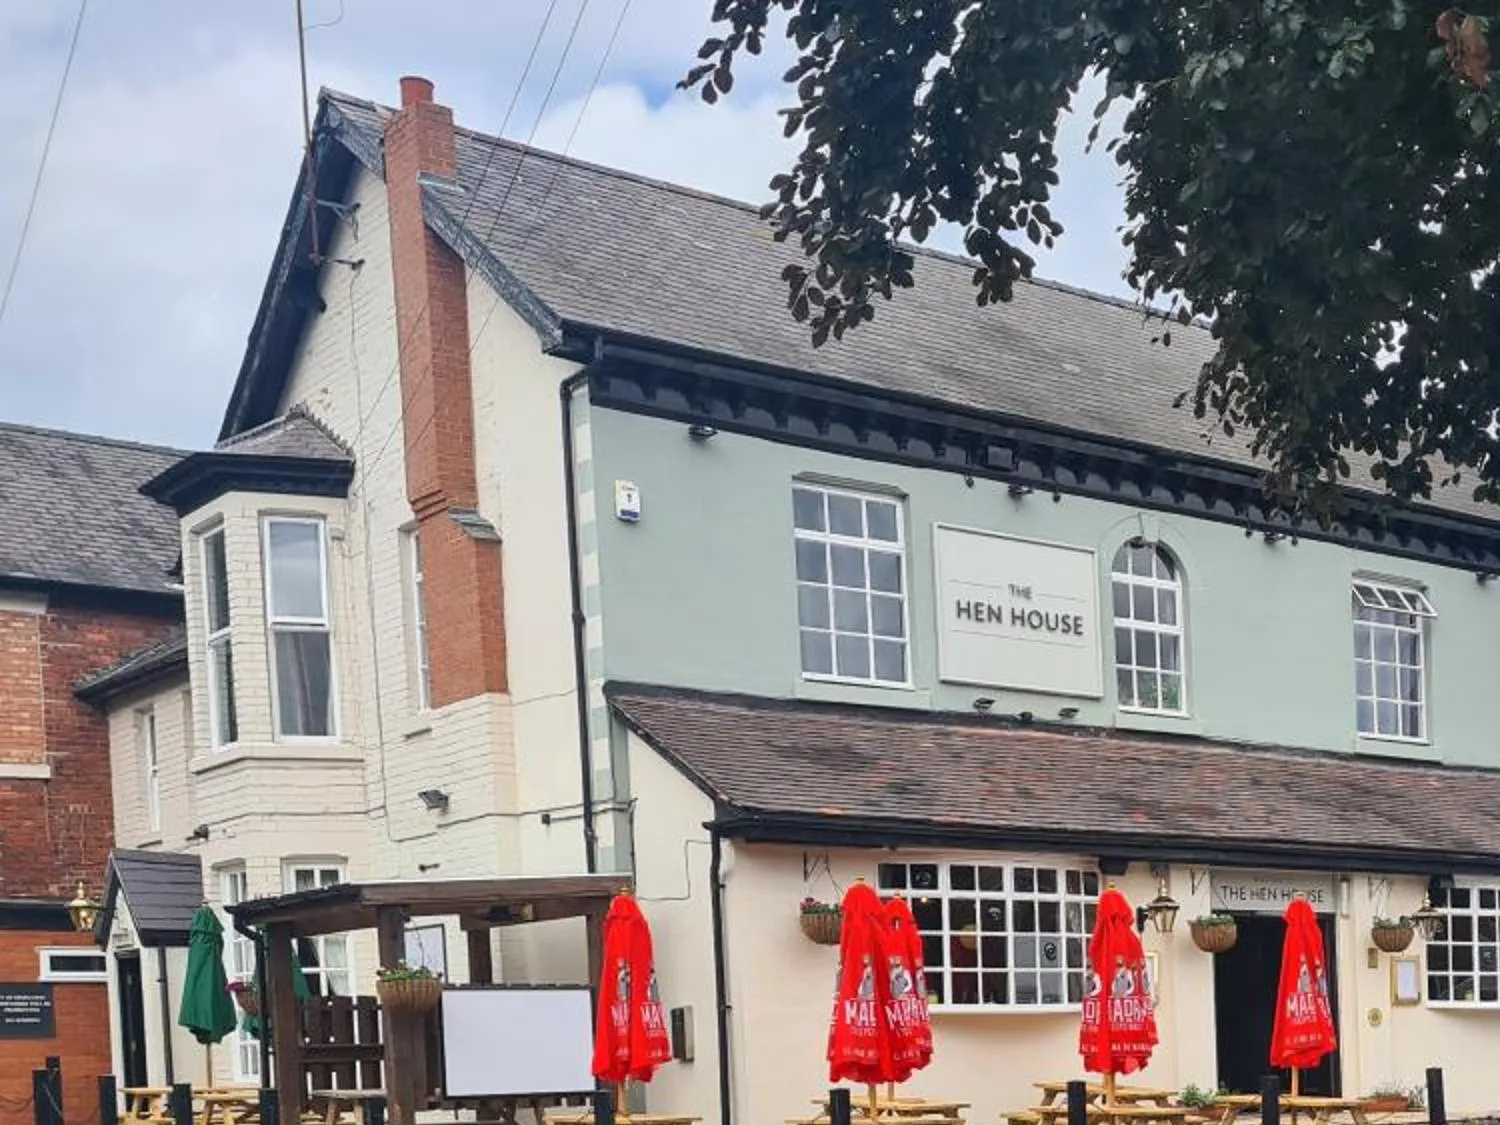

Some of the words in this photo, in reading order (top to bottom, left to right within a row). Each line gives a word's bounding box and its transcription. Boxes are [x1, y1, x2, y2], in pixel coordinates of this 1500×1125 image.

[1009, 584, 1031, 599] THE
[956, 600, 1002, 624] HEN
[1011, 608, 1083, 635] HOUSE
[1221, 885, 1247, 901] THE
[1250, 887, 1277, 902] HEN
[1281, 889, 1325, 903] HSE
